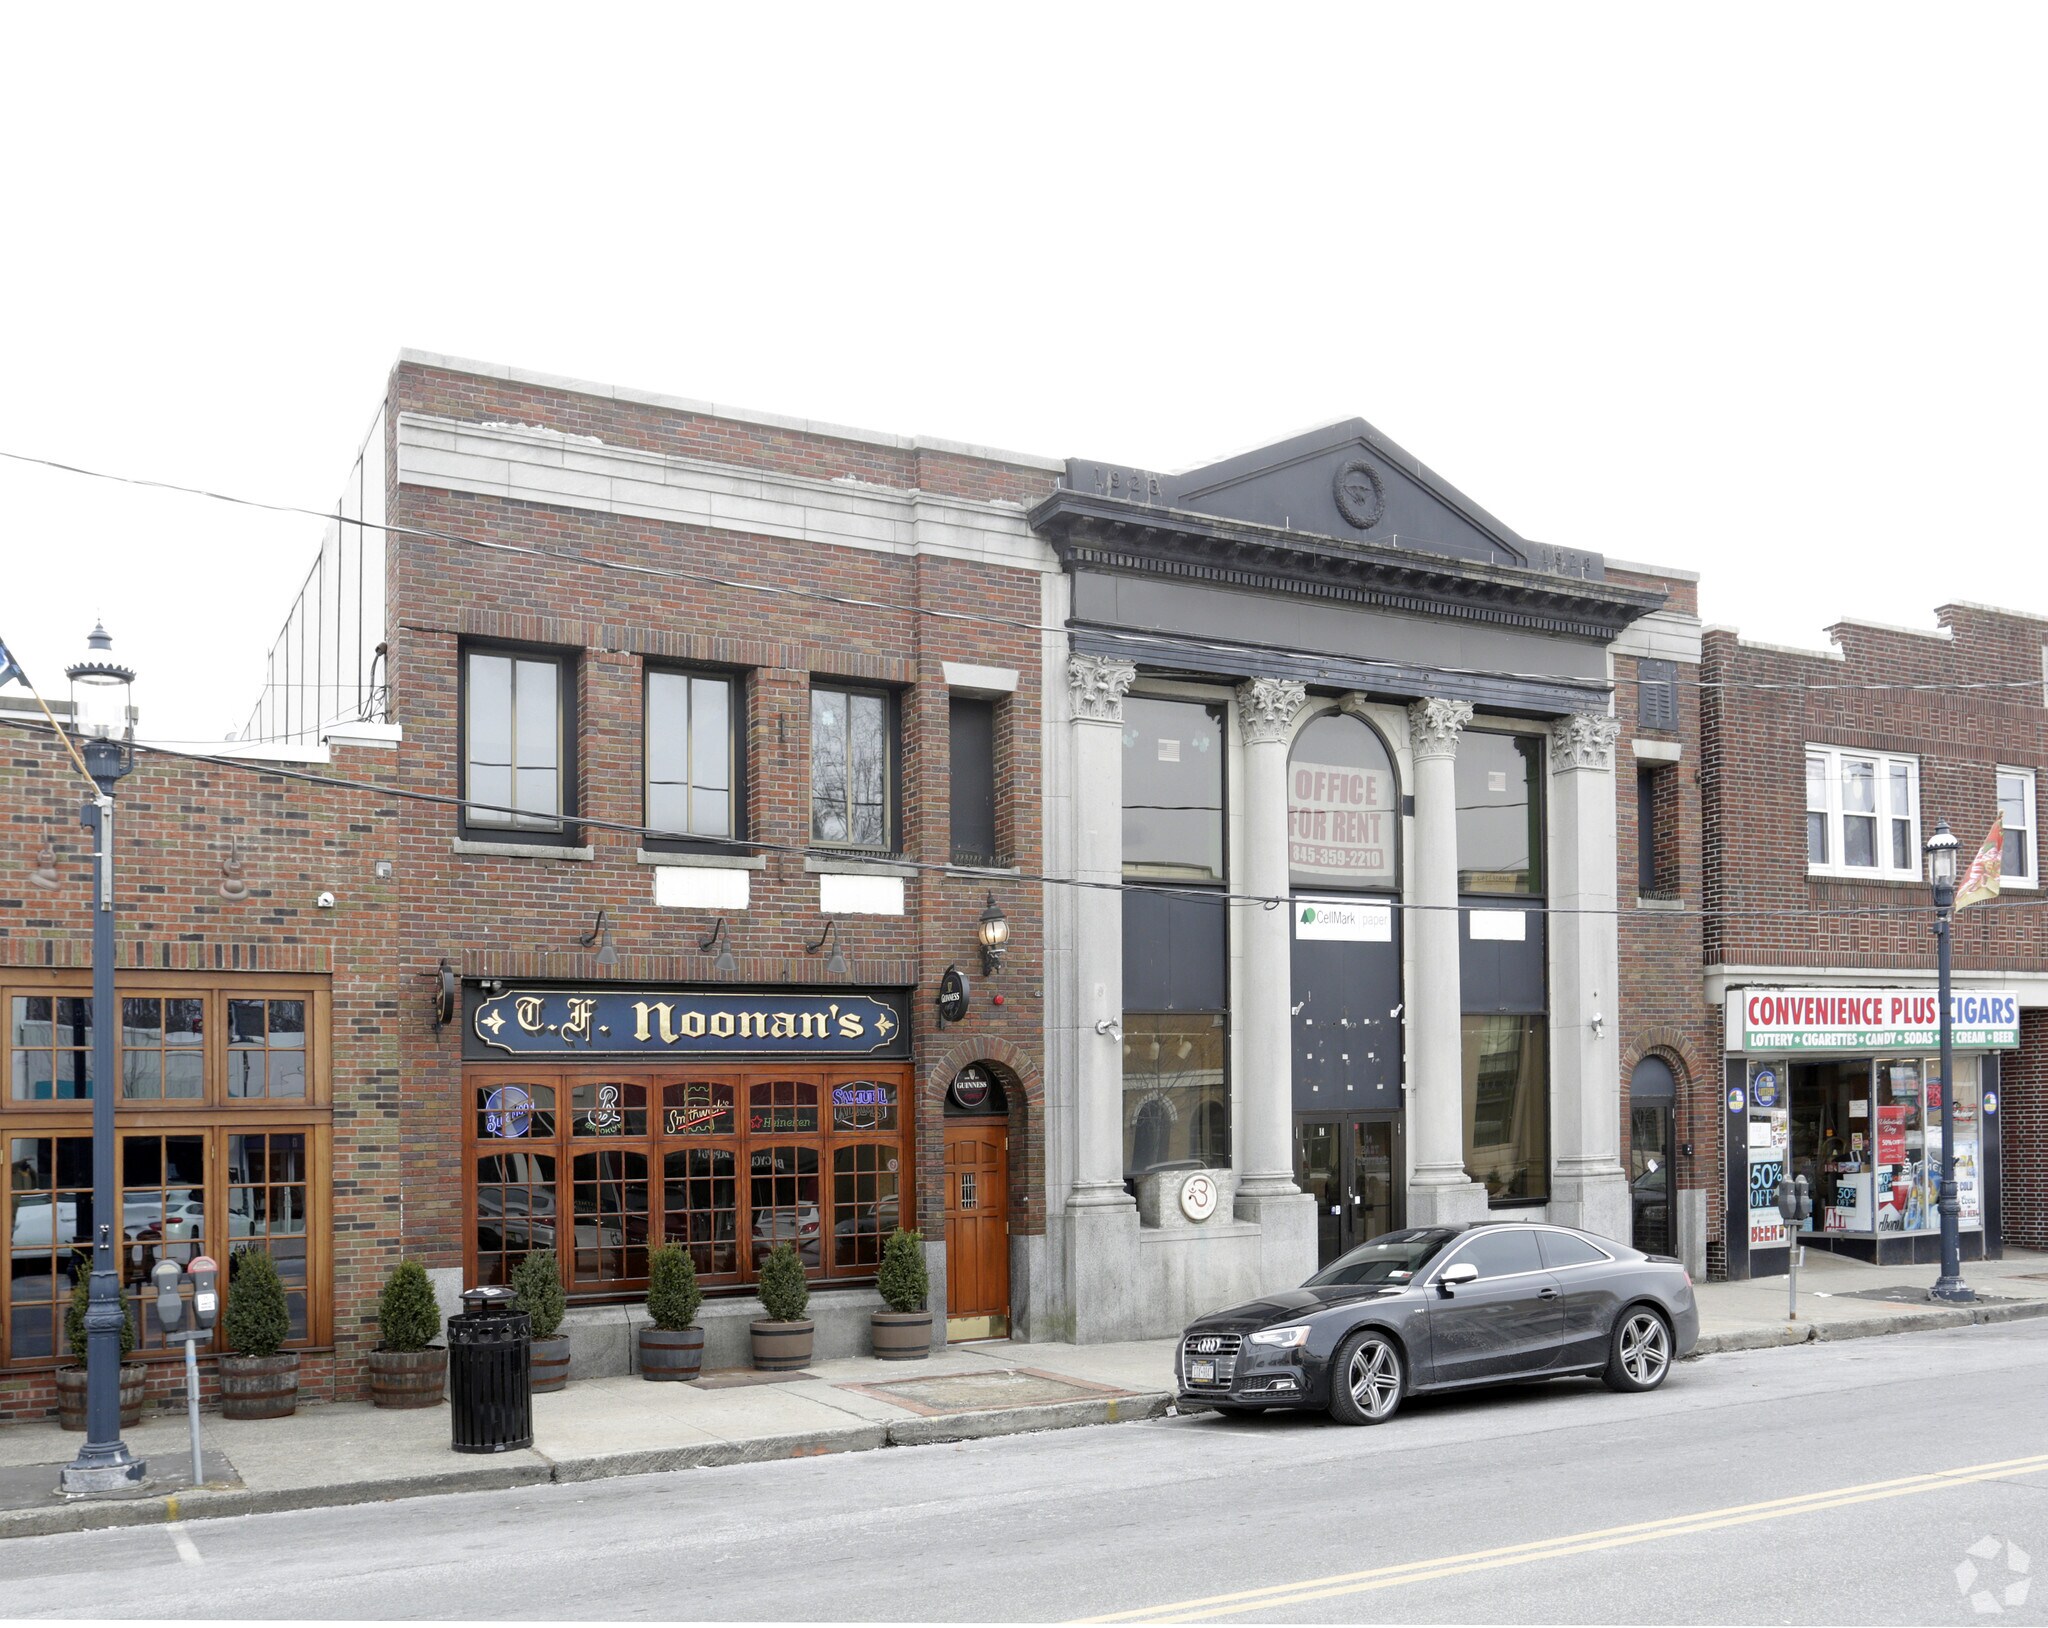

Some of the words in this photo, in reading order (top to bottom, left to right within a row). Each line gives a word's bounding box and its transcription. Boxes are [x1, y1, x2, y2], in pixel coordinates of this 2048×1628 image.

[1295, 769, 1377, 806] OFFICE
[1289, 805, 1327, 840] FOR
[1332, 811, 1382, 844] RENT
[1293, 845, 1381, 867] 845-359-2210
[1317, 910, 1356, 925] CellMark
[1362, 914, 1388, 929] paper
[941, 992, 960, 1003] GUINNESS
[1748, 996, 1883, 1026] CONVENIENCE
[1891, 997, 1936, 1025] PLUS
[631, 1001, 864, 1044] Noonan's
[1750, 1032, 1794, 1047] LOTTERY
[1802, 1032, 1858, 1047] CIGARETTES
[1865, 1031, 1897, 1047] CANDY
[1904, 1031, 1934, 1045] SODAS
[1956, 1030, 1987, 1044] CREAM
[1993, 1030, 2015, 1044] BEER
[956, 1081, 987, 1090] GUINNESS
[763, 1117, 812, 1128] Heineen
[1750, 1163, 1783, 1190] 50%
[1750, 1188, 1774, 1207] OFF
[1837, 1187, 1857, 1199] 50%
